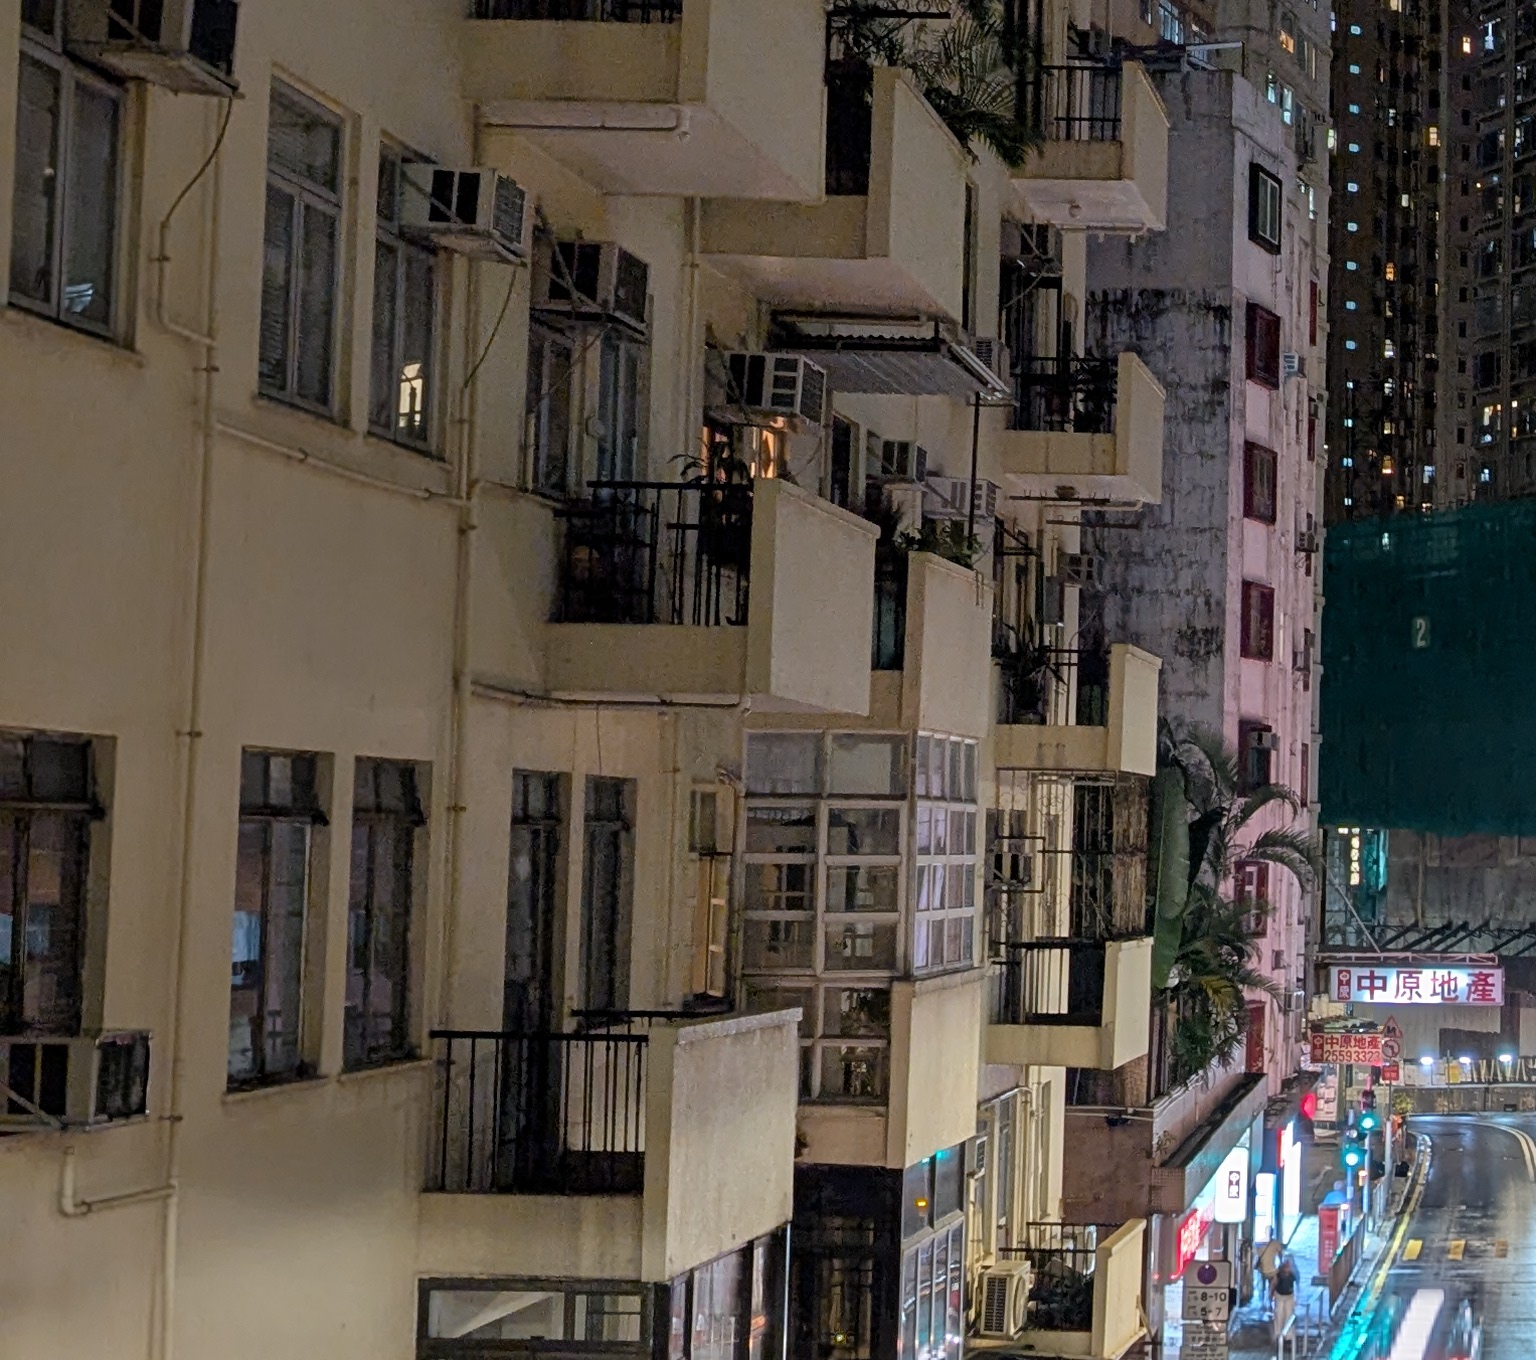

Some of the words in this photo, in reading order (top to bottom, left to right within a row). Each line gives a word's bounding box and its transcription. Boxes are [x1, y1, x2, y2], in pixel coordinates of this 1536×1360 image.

[1416, 618, 1427, 648] 2
[1357, 969, 1496, 1002] 中原地產
[1324, 1034, 1381, 1050] 中原地產
[1201, 1291, 1227, 1302] 8-10
